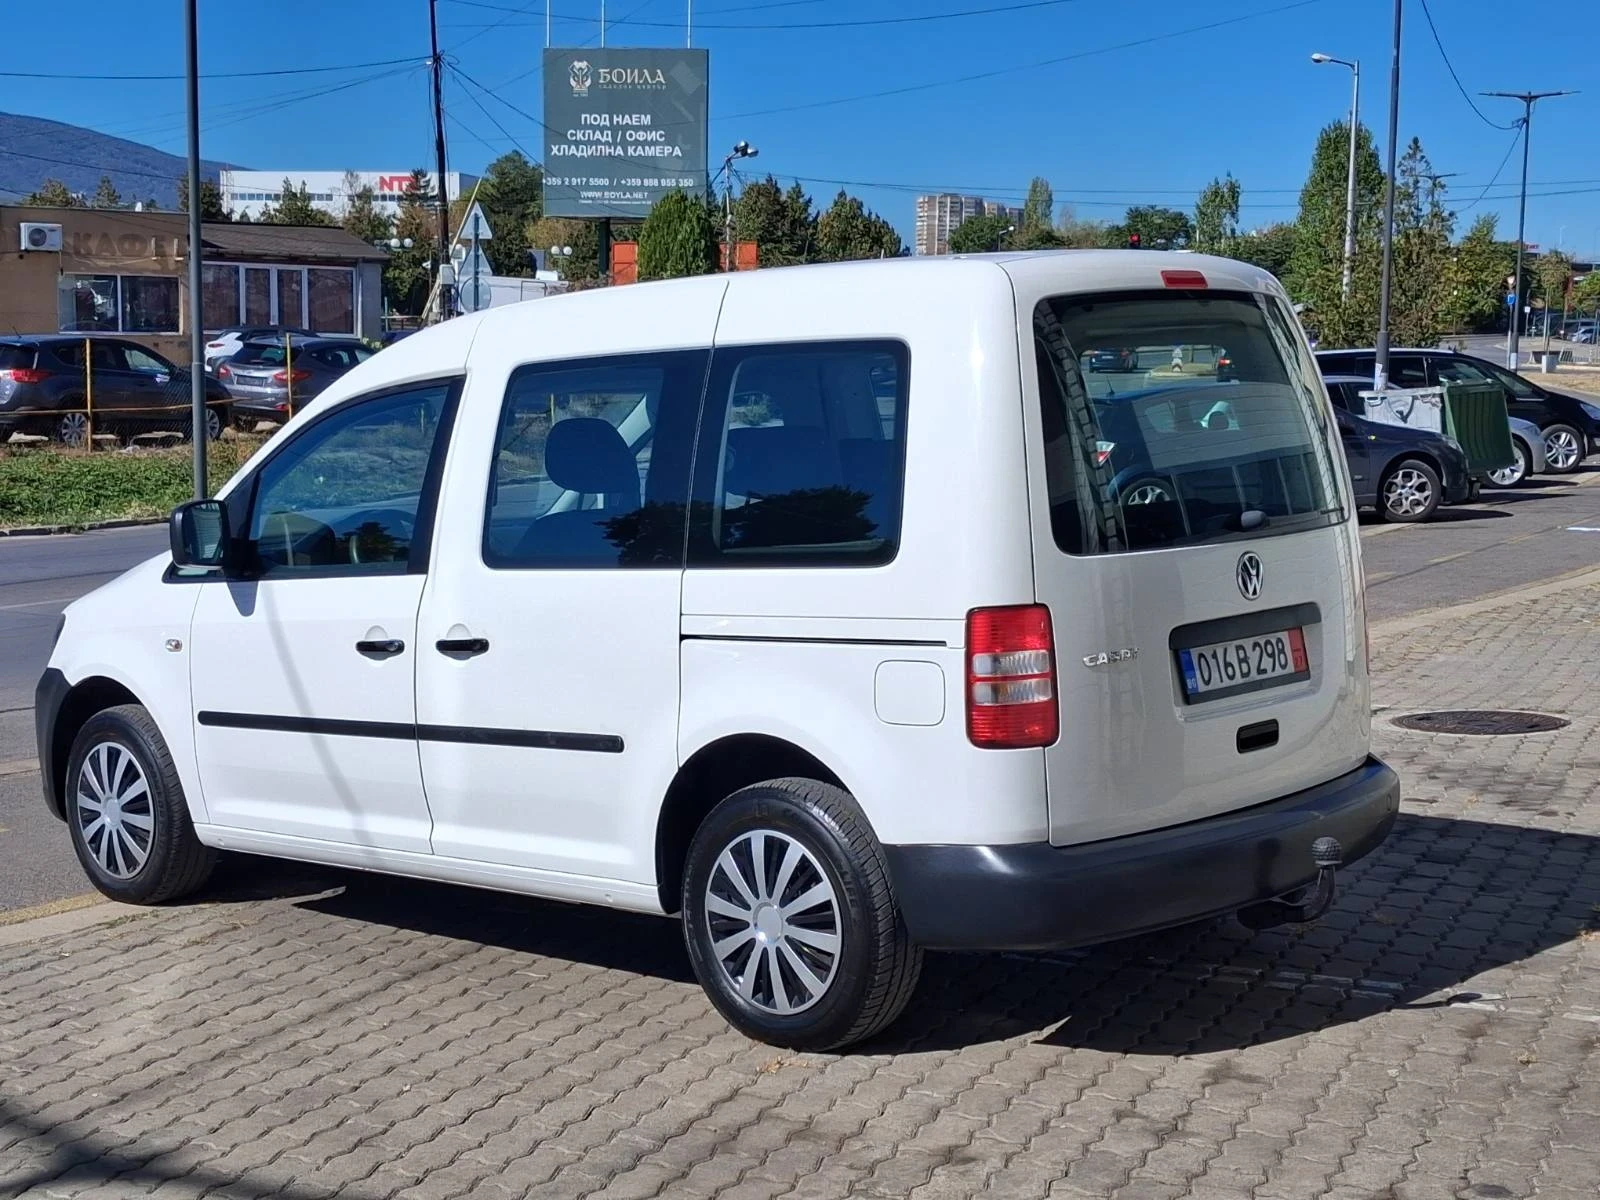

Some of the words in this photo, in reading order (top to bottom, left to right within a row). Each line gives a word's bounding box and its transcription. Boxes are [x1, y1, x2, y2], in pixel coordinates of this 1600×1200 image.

[598, 68, 666, 84] БОИЛА
[581, 114, 610, 127] ПОД
[613, 114, 651, 126] НАЕМ
[567, 130, 612, 143] СКЛАД
[626, 131, 666, 142] ОФИС
[551, 145, 624, 158] ХЛАДИЛНА
[627, 145, 682, 157] КАМЕРА
[563, 177, 570, 186] 2
[589, 177, 609, 186] 5500
[620, 178, 642, 187] +359
